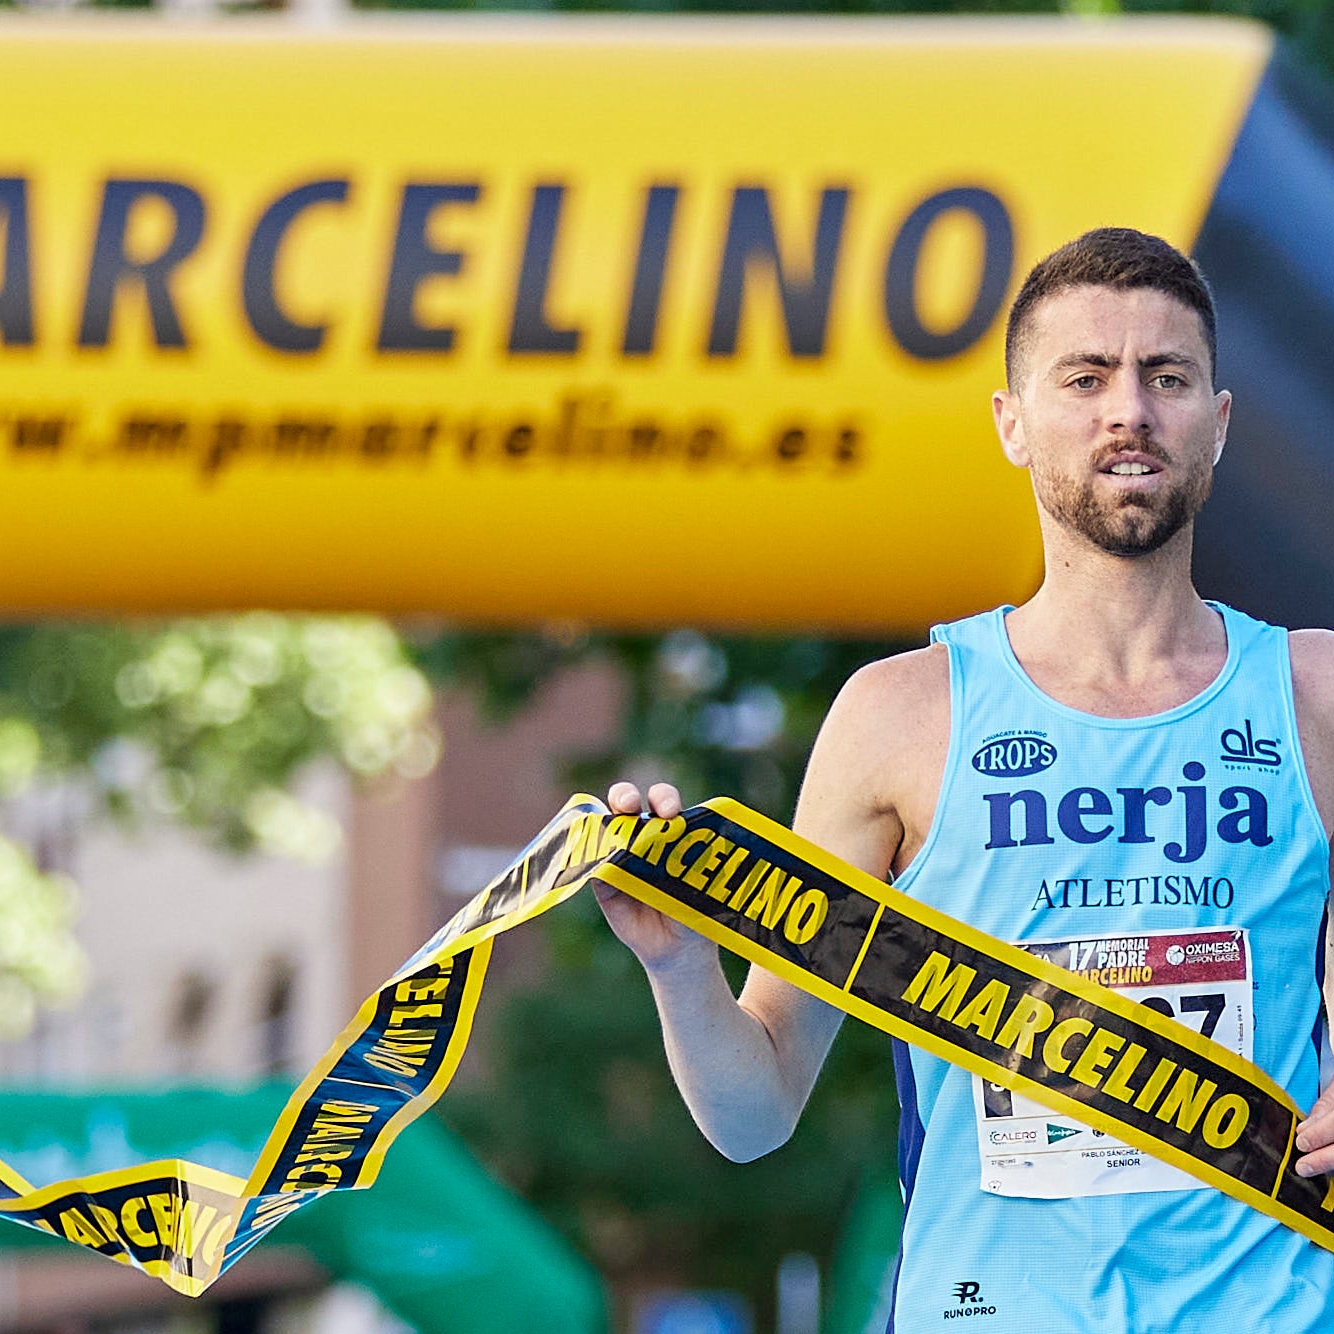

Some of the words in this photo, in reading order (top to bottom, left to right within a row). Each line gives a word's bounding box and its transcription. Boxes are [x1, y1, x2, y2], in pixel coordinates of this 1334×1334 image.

[976, 739, 1053, 770] TROPS
[983, 761, 1274, 863] nerja
[561, 812, 829, 946] MARCELINO
[1031, 875, 1234, 911] ATLETISMO
[1068, 941, 1097, 971] 17
[1096, 938, 1149, 953] MEMORIAL
[1185, 941, 1240, 955] OXIMESA
[1214, 953, 1241, 962] GASES
[1097, 950, 1147, 969] PADRE
[900, 949, 1251, 1150] MARCELINO
[993, 1131, 1037, 1141] CALERO
[1106, 1158, 1141, 1168] SENIOR
